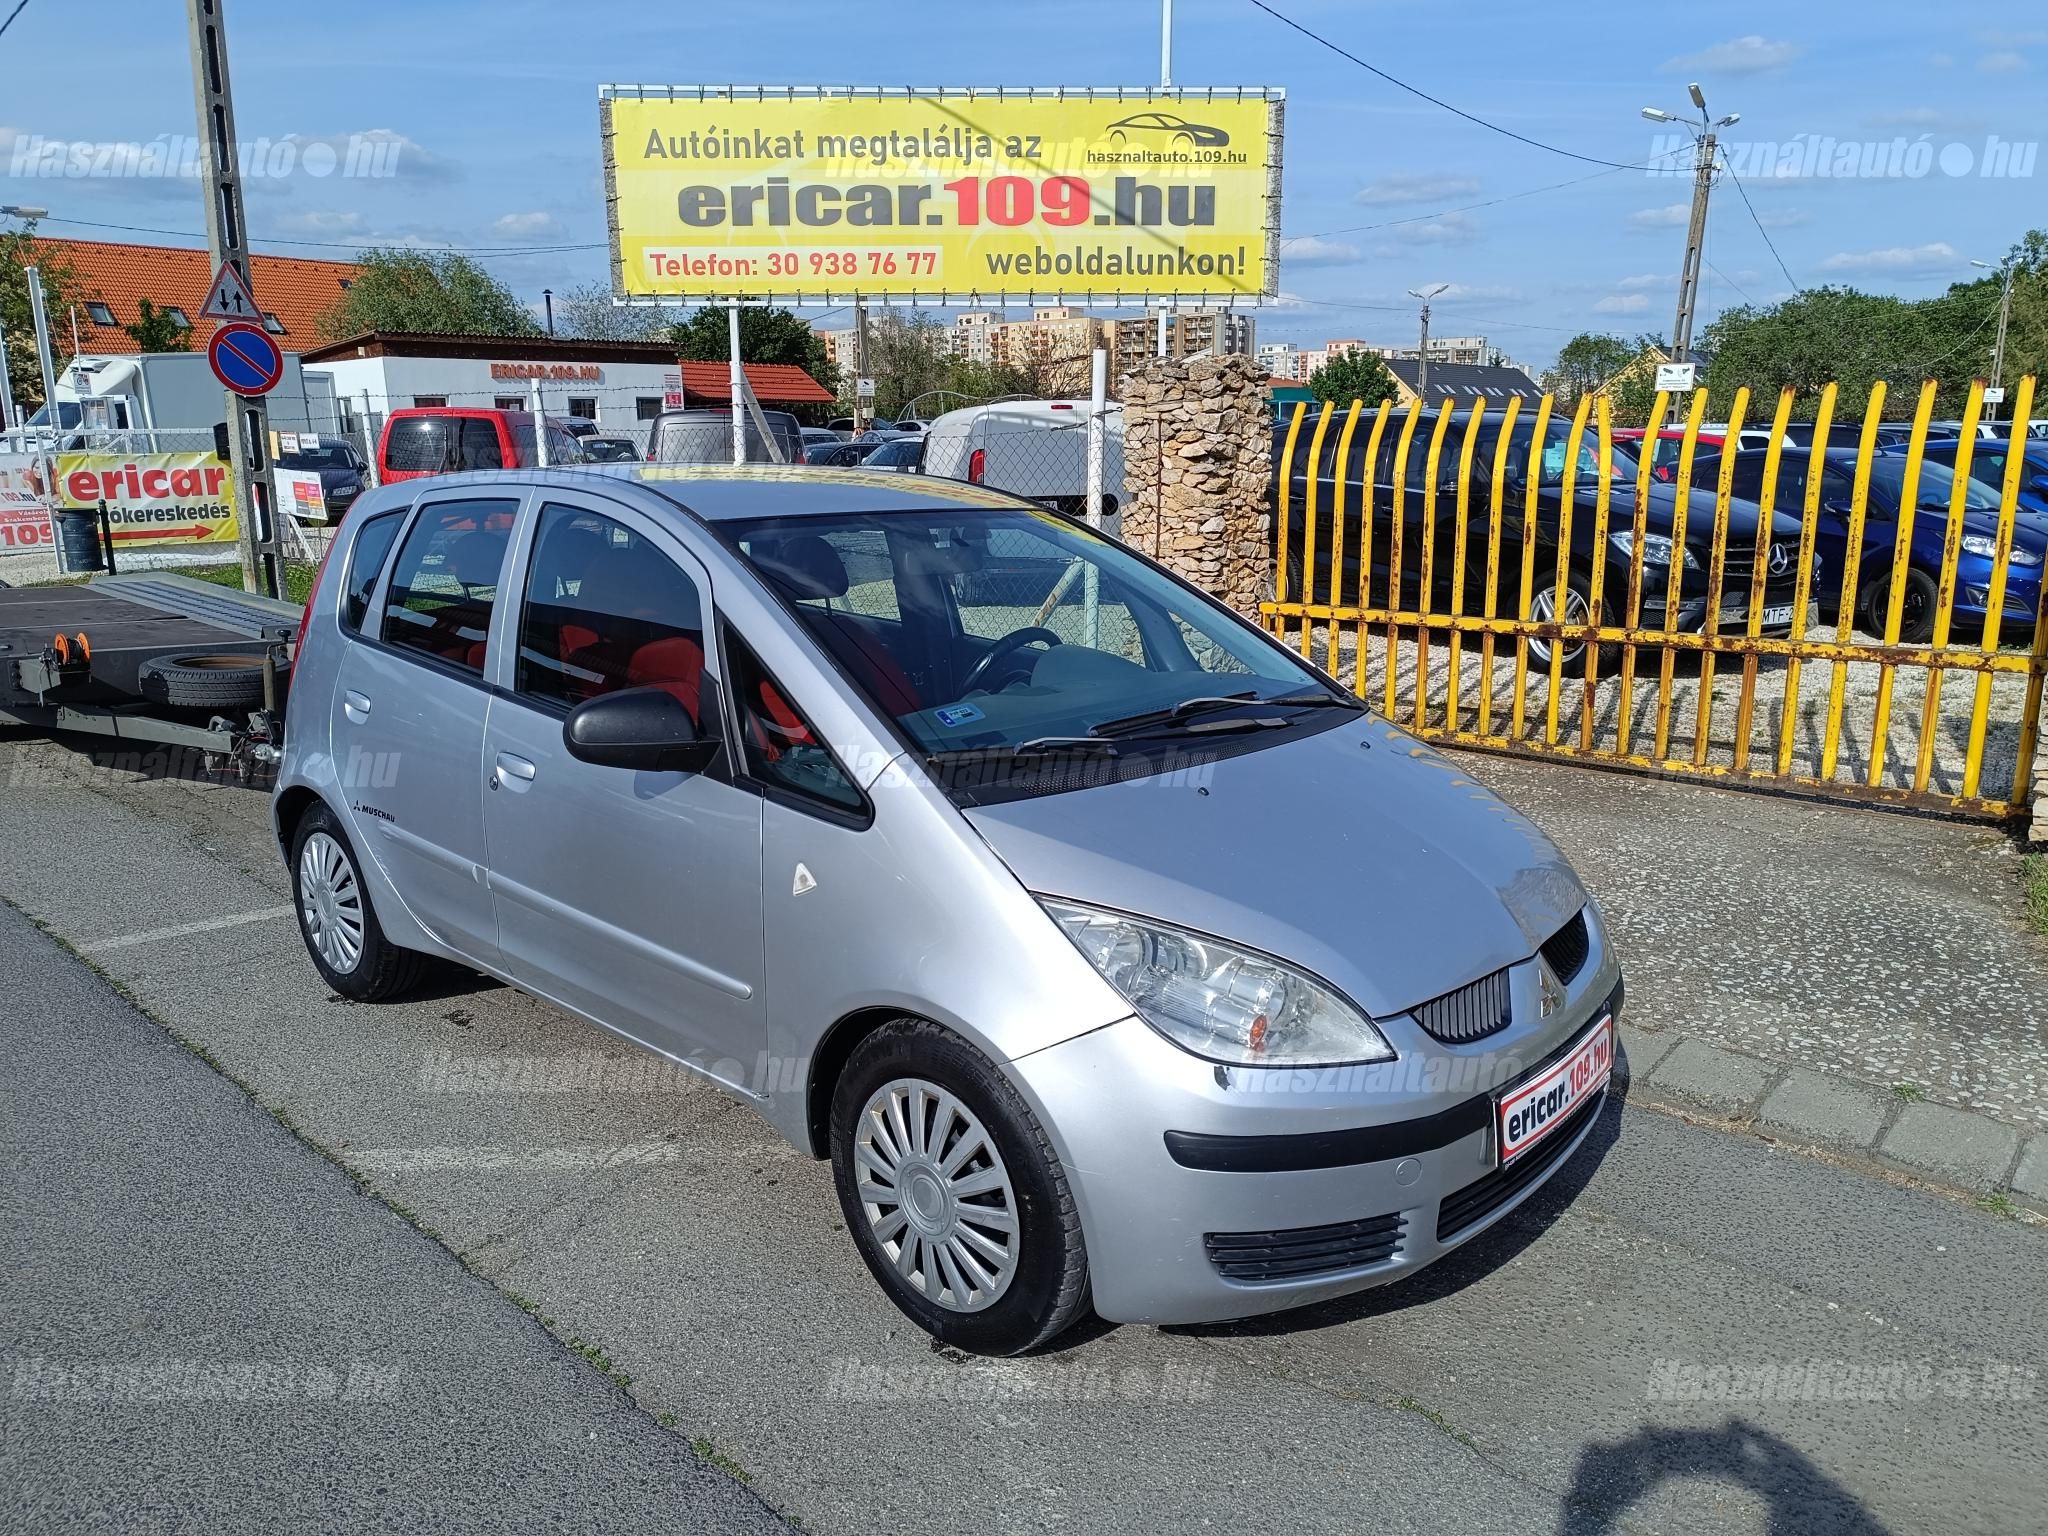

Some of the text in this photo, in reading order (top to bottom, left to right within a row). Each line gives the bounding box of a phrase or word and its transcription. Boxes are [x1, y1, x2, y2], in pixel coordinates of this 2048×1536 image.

[644, 123, 1042, 166] Autóinkat megtalálja az
[1087, 150, 1247, 163] hasznaltauto.109.hu
[677, 176, 1216, 227] ericar.109.hu
[649, 252, 937, 276] Telefon: 30 938 76 77
[986, 246, 1246, 276] weboldalunkon!
[490, 363, 600, 380] ERICAR.109.HU
[68, 463, 225, 501] ericar
[100, 502, 231, 523] ókereskedés
[1763, 606, 1794, 624] MTF-2
[361, 804, 395, 823] MUSCHAU
[1508, 1037, 1609, 1143] ericar.109.hu
